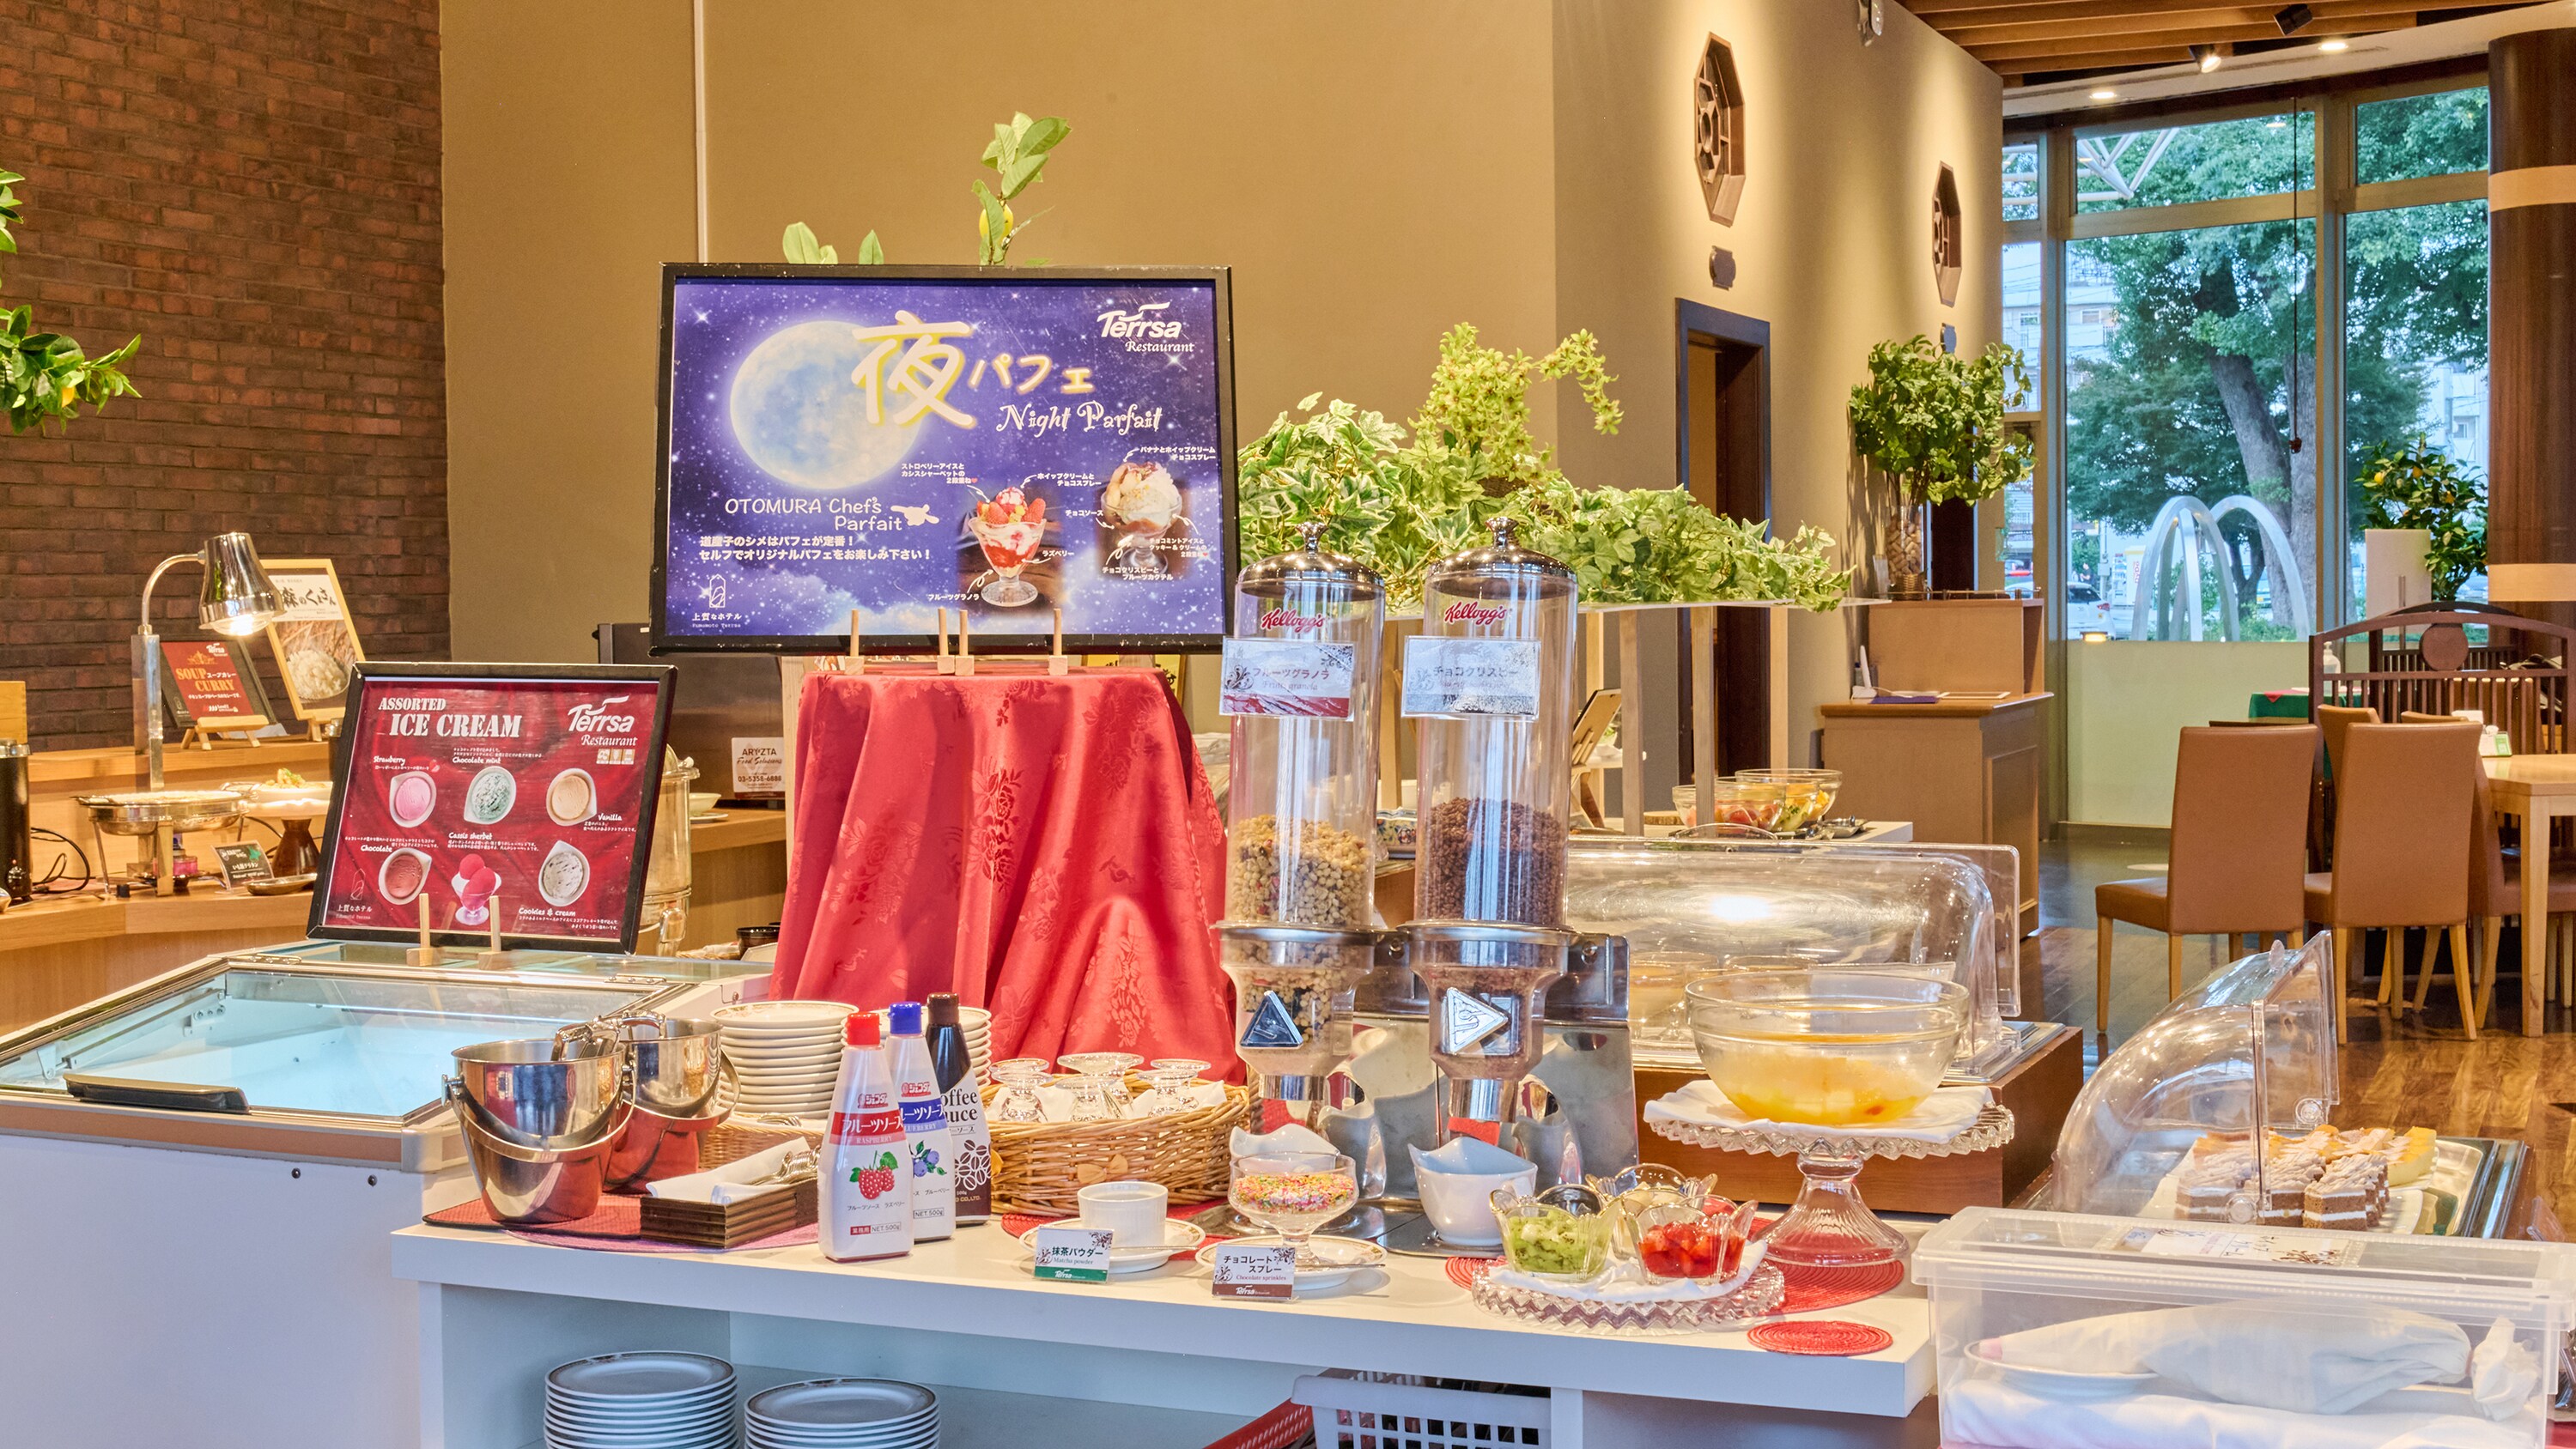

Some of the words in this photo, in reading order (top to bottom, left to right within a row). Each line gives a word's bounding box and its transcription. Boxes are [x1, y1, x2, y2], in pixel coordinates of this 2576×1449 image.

[1097, 302, 1182, 338] Terrsa
[1125, 341, 1194, 353] Restaurant
[996, 401, 1072, 438] Night
[1077, 400, 1163, 436] Parfait
[725, 498, 822, 514] OTOMURA
[829, 496, 883, 514] Chef's
[835, 515, 902, 530] Parfait
[700, 536, 854, 547] 道産子のシメはパフェが定番！
[699, 549, 931, 561] セルフでオリジナルパフェをお楽しみ下さい！
[692, 612, 742, 621] 上質なホテル
[1444, 601, 1507, 625] Kellogg's
[1261, 608, 1326, 633] Kellogg's
[175, 668, 206, 680] SOUP
[195, 679, 234, 691] CURRY
[378, 697, 447, 711] ASSORTED
[568, 695, 635, 732] Terrsa
[389, 713, 429, 736] ICE
[436, 714, 523, 738] CREAM
[581, 734, 638, 746] Restaurant
[373, 755, 406, 766] Strawberry
[737, 756, 753, 765] Food
[361, 844, 393, 852] Chocolate
[519, 907, 545, 916] Cookies
[940, 1088, 979, 1108] offee
[842, 1115, 903, 1134] フルーツソース
[905, 1123, 937, 1132] LUEBERRY
[1052, 1246, 1103, 1258] 抹茶パウダー
[1224, 1255, 1273, 1264] チョコレート
